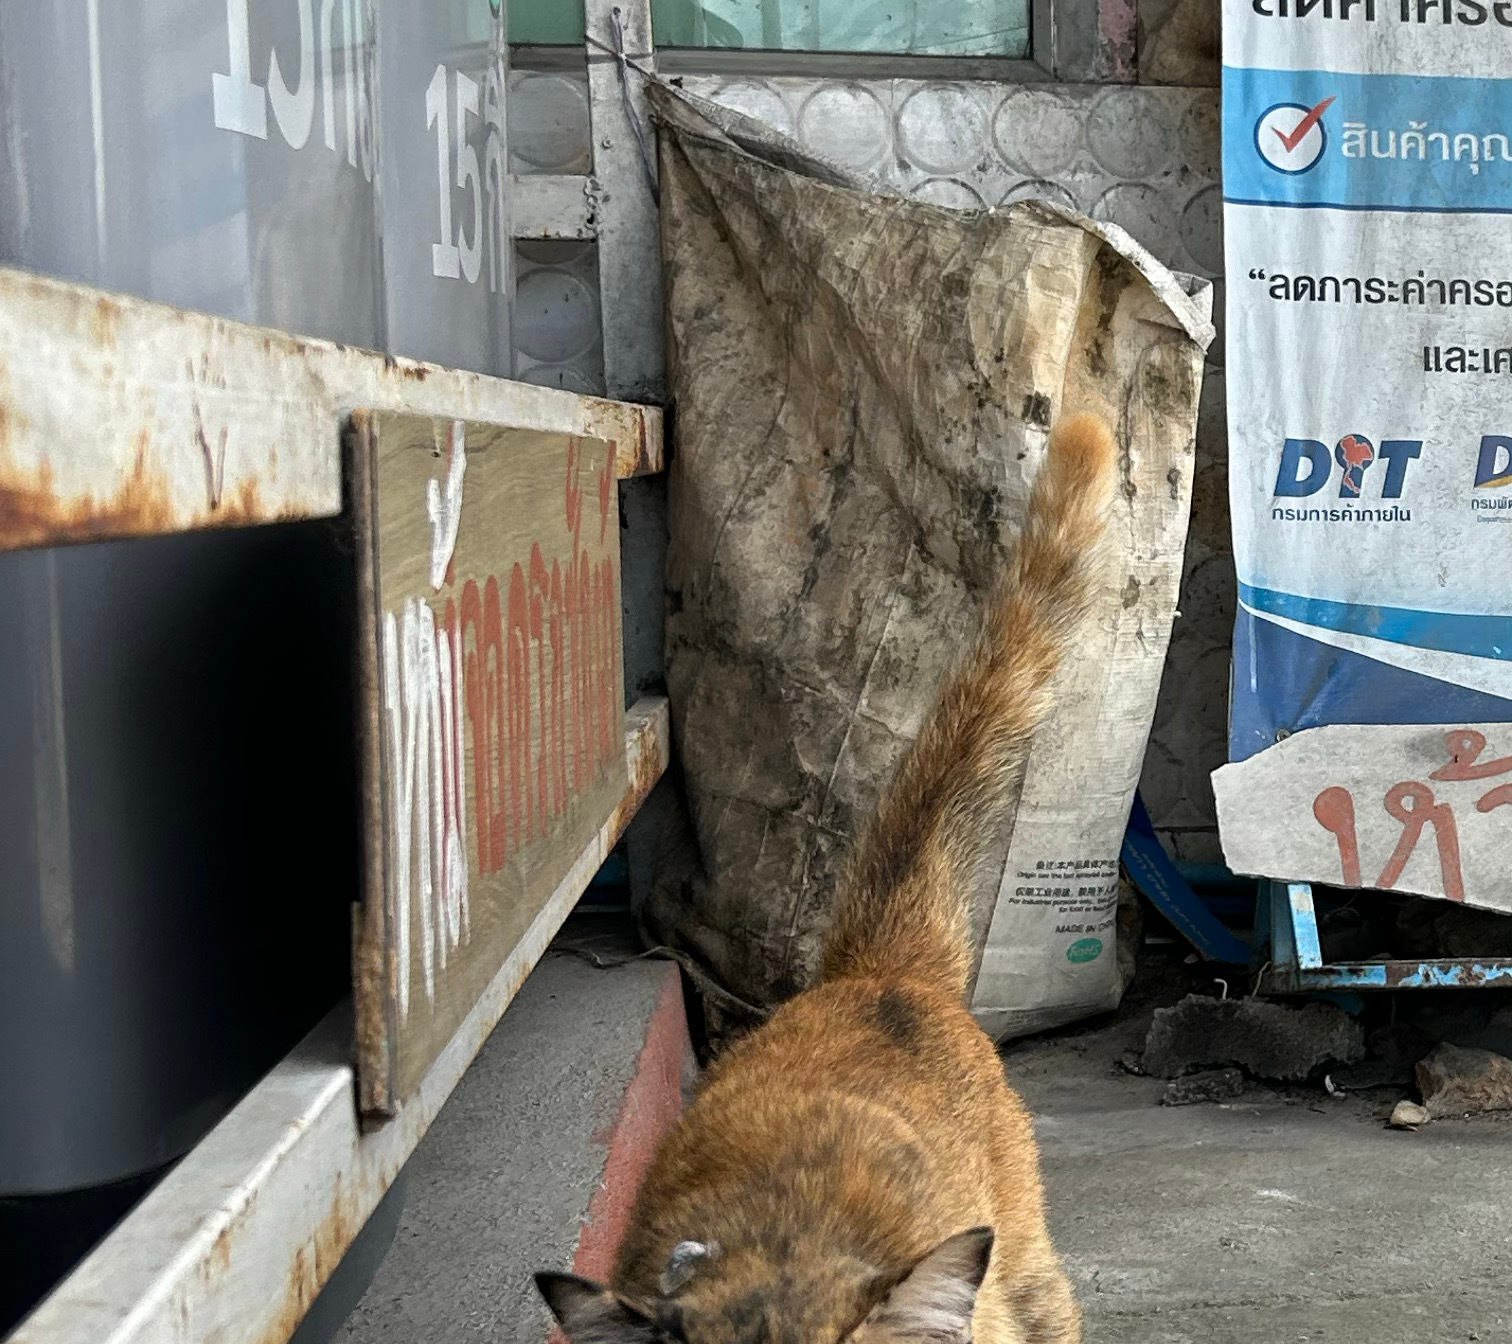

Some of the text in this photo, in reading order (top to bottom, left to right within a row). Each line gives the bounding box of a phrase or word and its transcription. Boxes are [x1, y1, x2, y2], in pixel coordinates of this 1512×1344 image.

[1273, 434, 1424, 498] DIT
[1272, 504, 1411, 523] กรมการค้าภายใน
